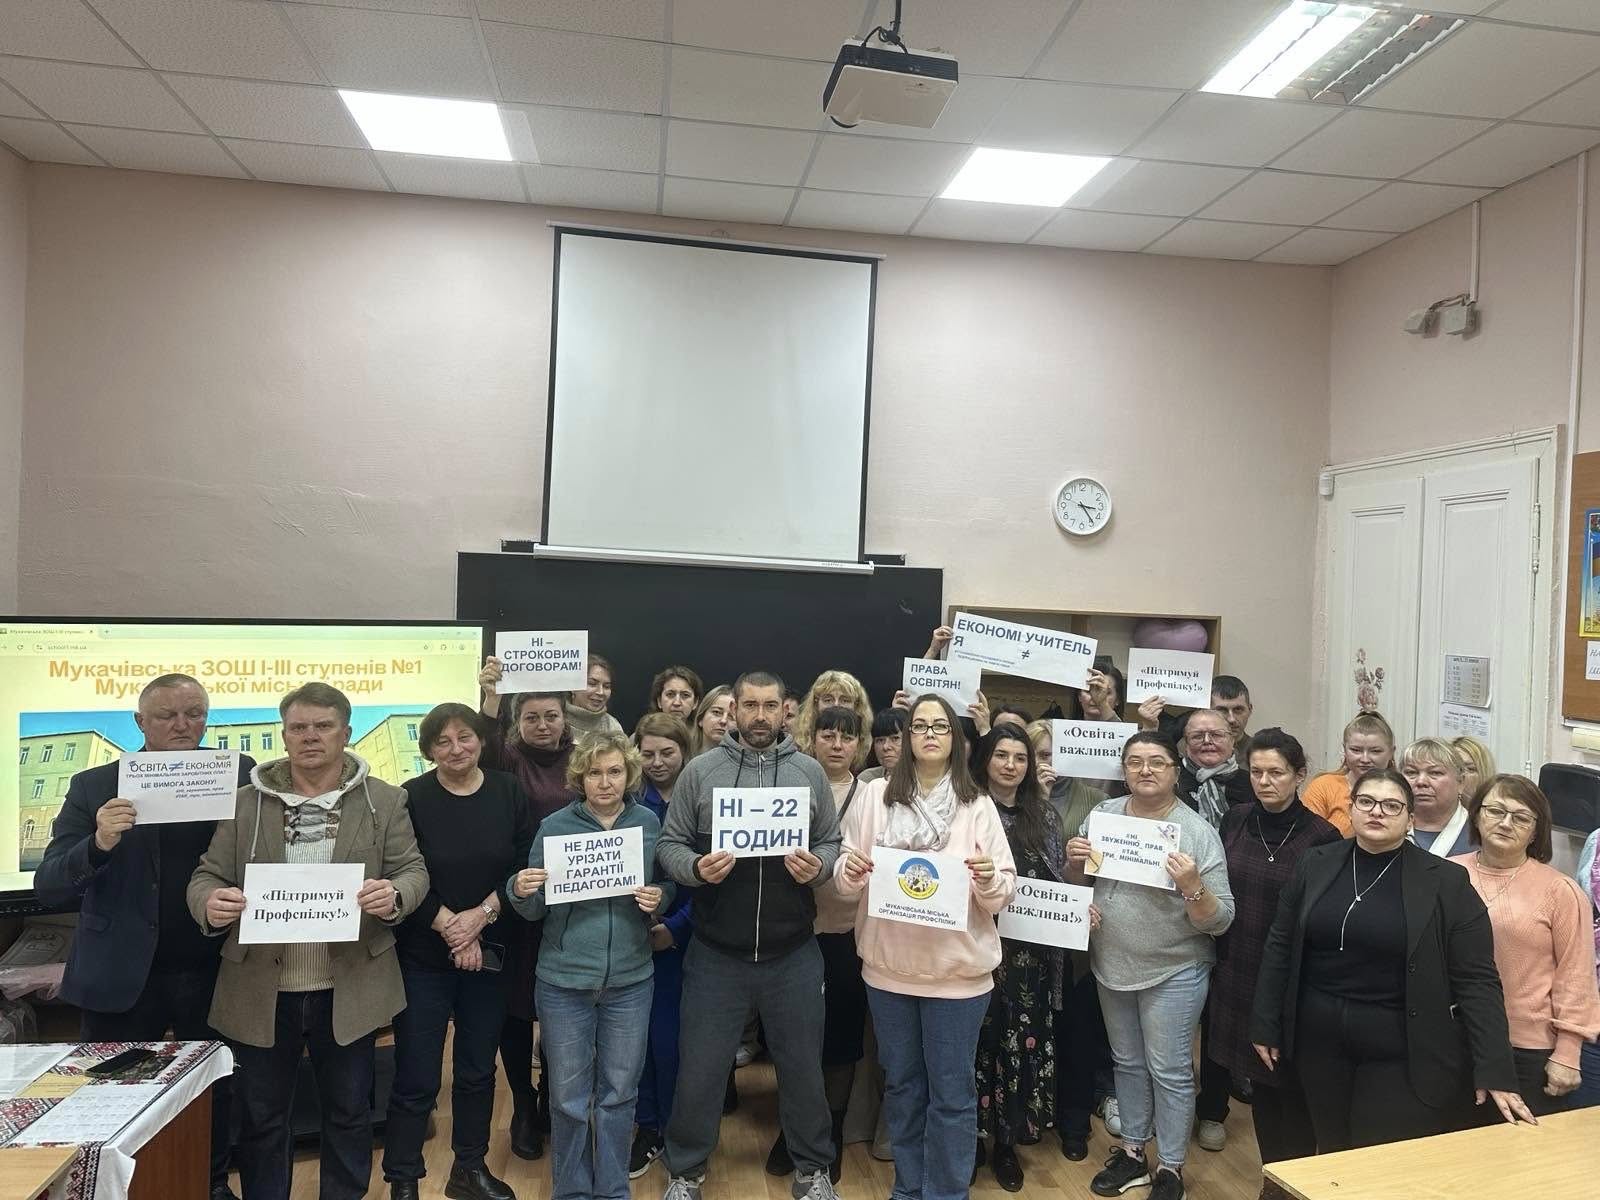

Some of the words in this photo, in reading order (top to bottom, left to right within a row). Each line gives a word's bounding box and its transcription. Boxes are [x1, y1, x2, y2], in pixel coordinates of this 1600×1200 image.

[1097, 502, 1104, 511] 3
[1095, 512, 1101, 520] 4
[1070, 519, 1076, 527] 7
[531, 637, 543, 647] НІ
[953, 635, 964, 647] Я
[957, 618, 1022, 642] ЕКОНОМІ
[1025, 632, 1092, 656] УЧИТЕЛЬ
[504, 649, 579, 660] СТРОКОВИМ
[49, 660, 196, 681] Мукачівська
[201, 659, 255, 677] ЗОШ
[296, 660, 386, 679] ступенів
[391, 659, 422, 674] №1
[501, 661, 582, 673] ДОГОВОРАМ!
[911, 663, 948, 675] ПРАВА
[1140, 665, 1199, 678] «Підтримуй
[334, 679, 383, 694] ради
[909, 676, 961, 690] ОСВІТЯН!
[1135, 678, 1203, 693] Профспілку!»
[1063, 726, 1115, 740] «Освіта
[1059, 745, 1122, 758] важлива!
[130, 762, 168, 772] ОСВІТА
[185, 761, 231, 770] ЕКОНОМІЯ
[719, 798, 743, 817] НІ
[771, 798, 798, 817] 22
[564, 841, 582, 852] НЕ
[585, 836, 624, 852] ДАМО
[719, 828, 803, 852] ГОДИН
[567, 850, 621, 866] УРІЗАТИ
[566, 861, 624, 879] ГАРАНТІЇ
[553, 875, 636, 894] ПЕДАГОГАМ!
[262, 890, 344, 903] «Підтримуй
[885, 902, 926, 914] МУКАЧІВСЬКА
[1007, 903, 1083, 924] важлива!»
[254, 908, 349, 922] Профспілку!»
[917, 914, 956, 926] ПРОФСПІЛКИ
